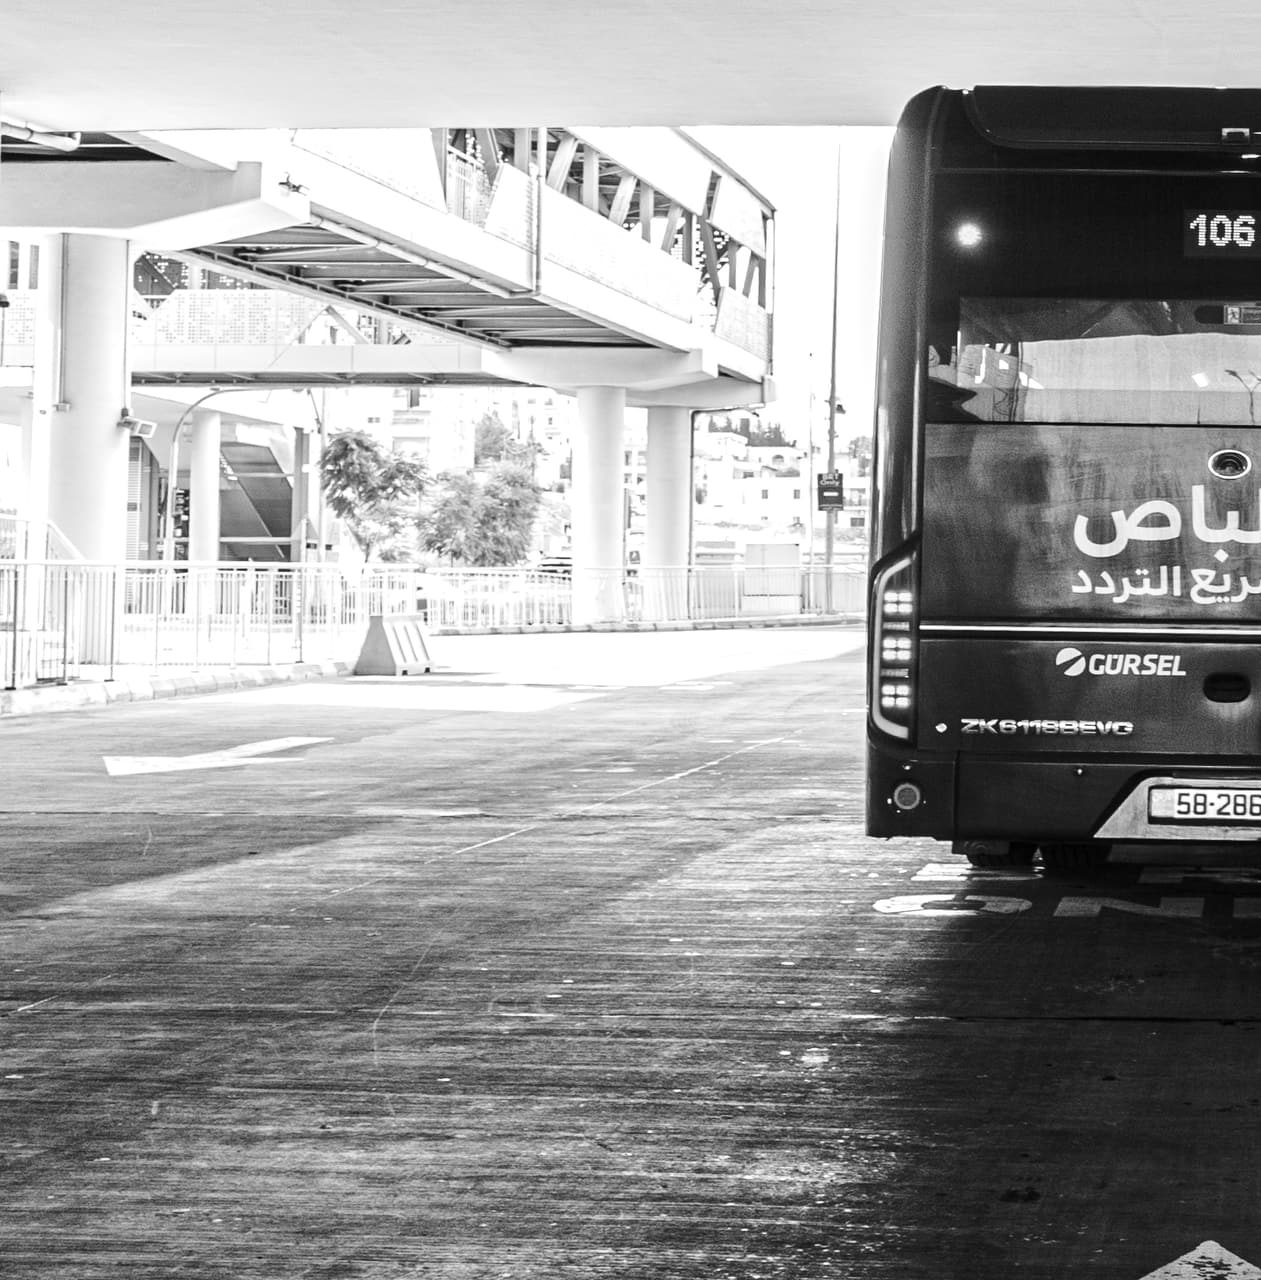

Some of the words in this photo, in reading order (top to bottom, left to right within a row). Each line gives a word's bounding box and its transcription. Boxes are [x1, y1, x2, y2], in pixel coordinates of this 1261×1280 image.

[1189, 214, 1256, 247] 106
[1072, 565, 1182, 604] التردد
[1088, 654, 1187, 677] GÜRSEL
[960, 718, 1134, 736] ZK6118BEVG
